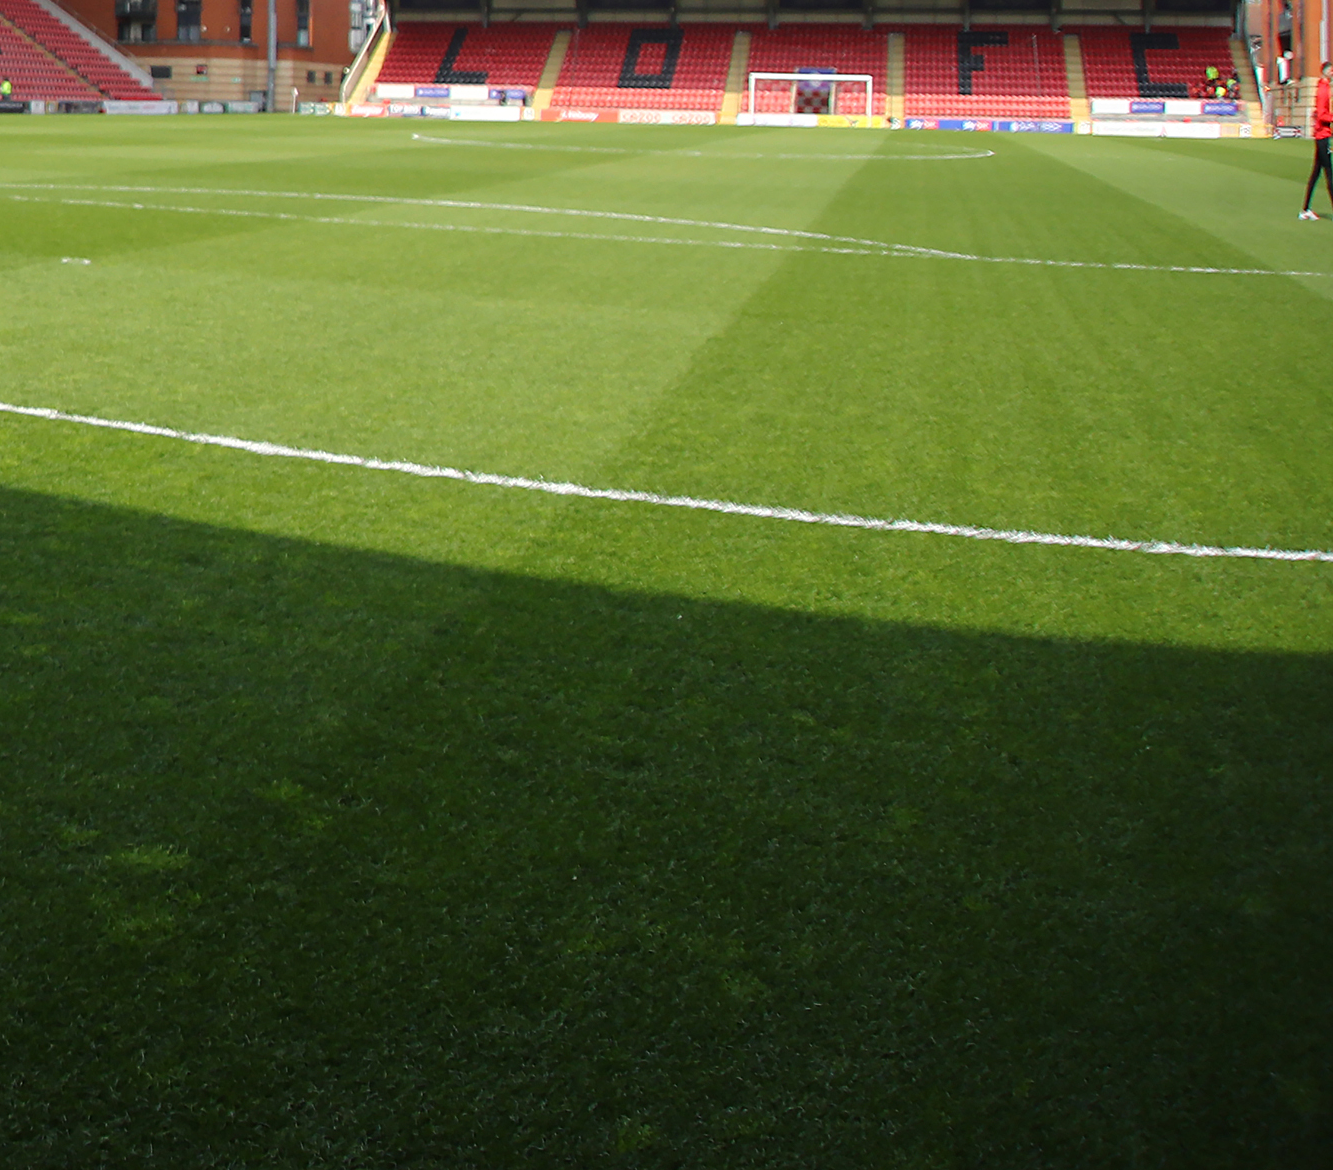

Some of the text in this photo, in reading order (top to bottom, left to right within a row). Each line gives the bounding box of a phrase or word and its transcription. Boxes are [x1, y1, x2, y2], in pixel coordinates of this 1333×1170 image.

[435, 27, 1188, 98] L O F C
